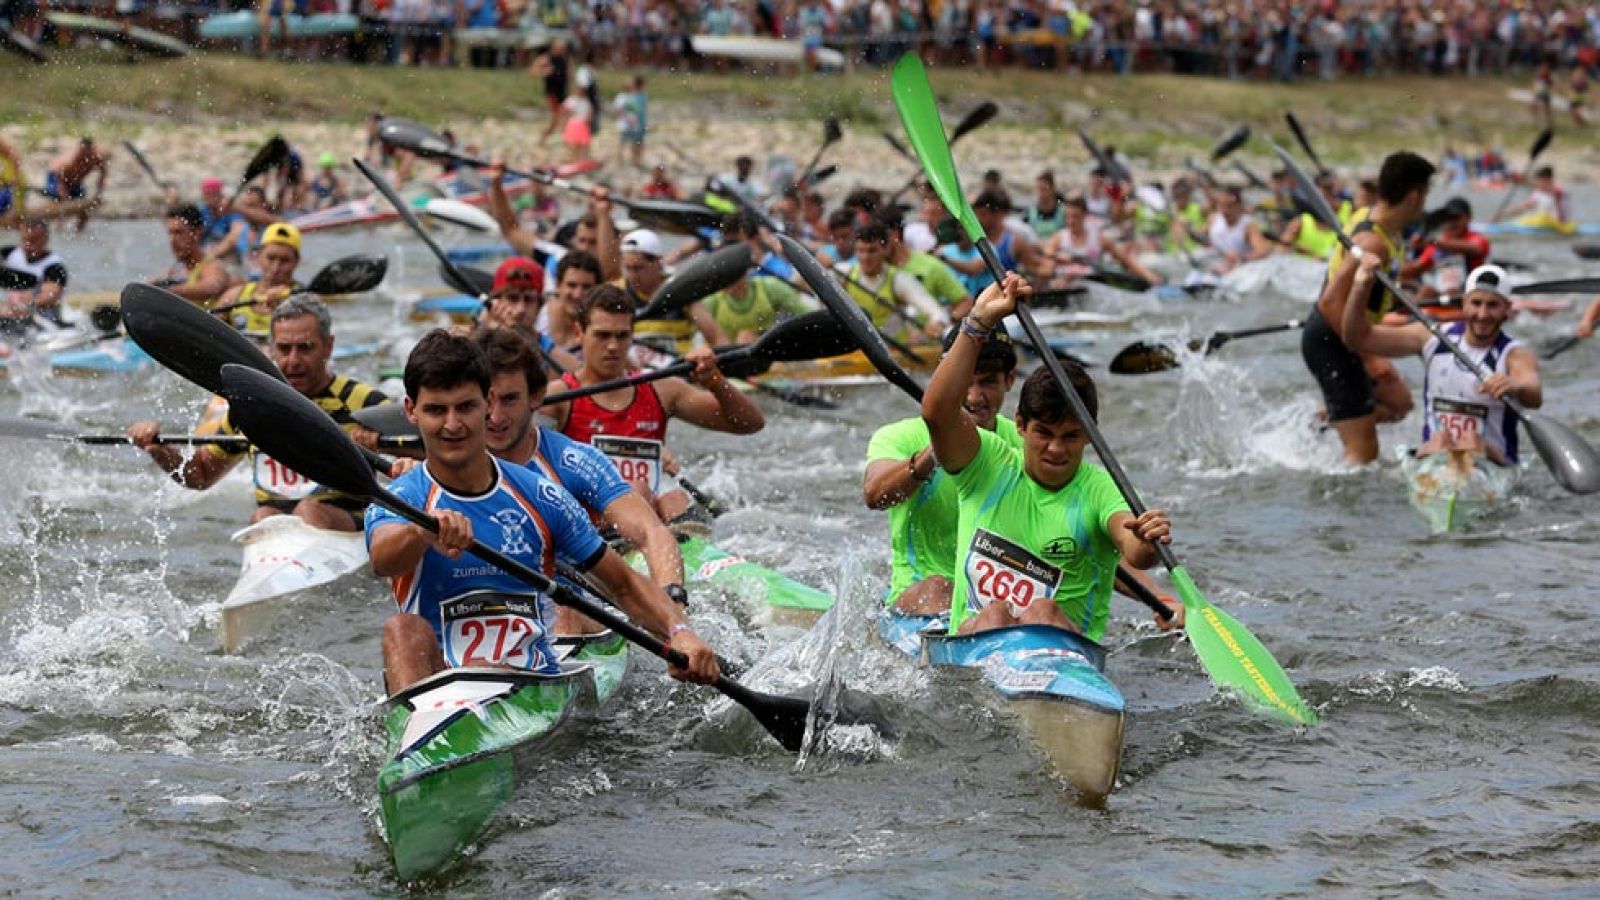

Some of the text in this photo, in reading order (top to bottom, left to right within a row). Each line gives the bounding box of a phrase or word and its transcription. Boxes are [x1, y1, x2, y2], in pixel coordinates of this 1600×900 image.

[974, 537, 1055, 581] Liber bank
[975, 560, 1035, 607] 260
[450, 601, 534, 616] Liber bank
[461, 618, 533, 666] 272
